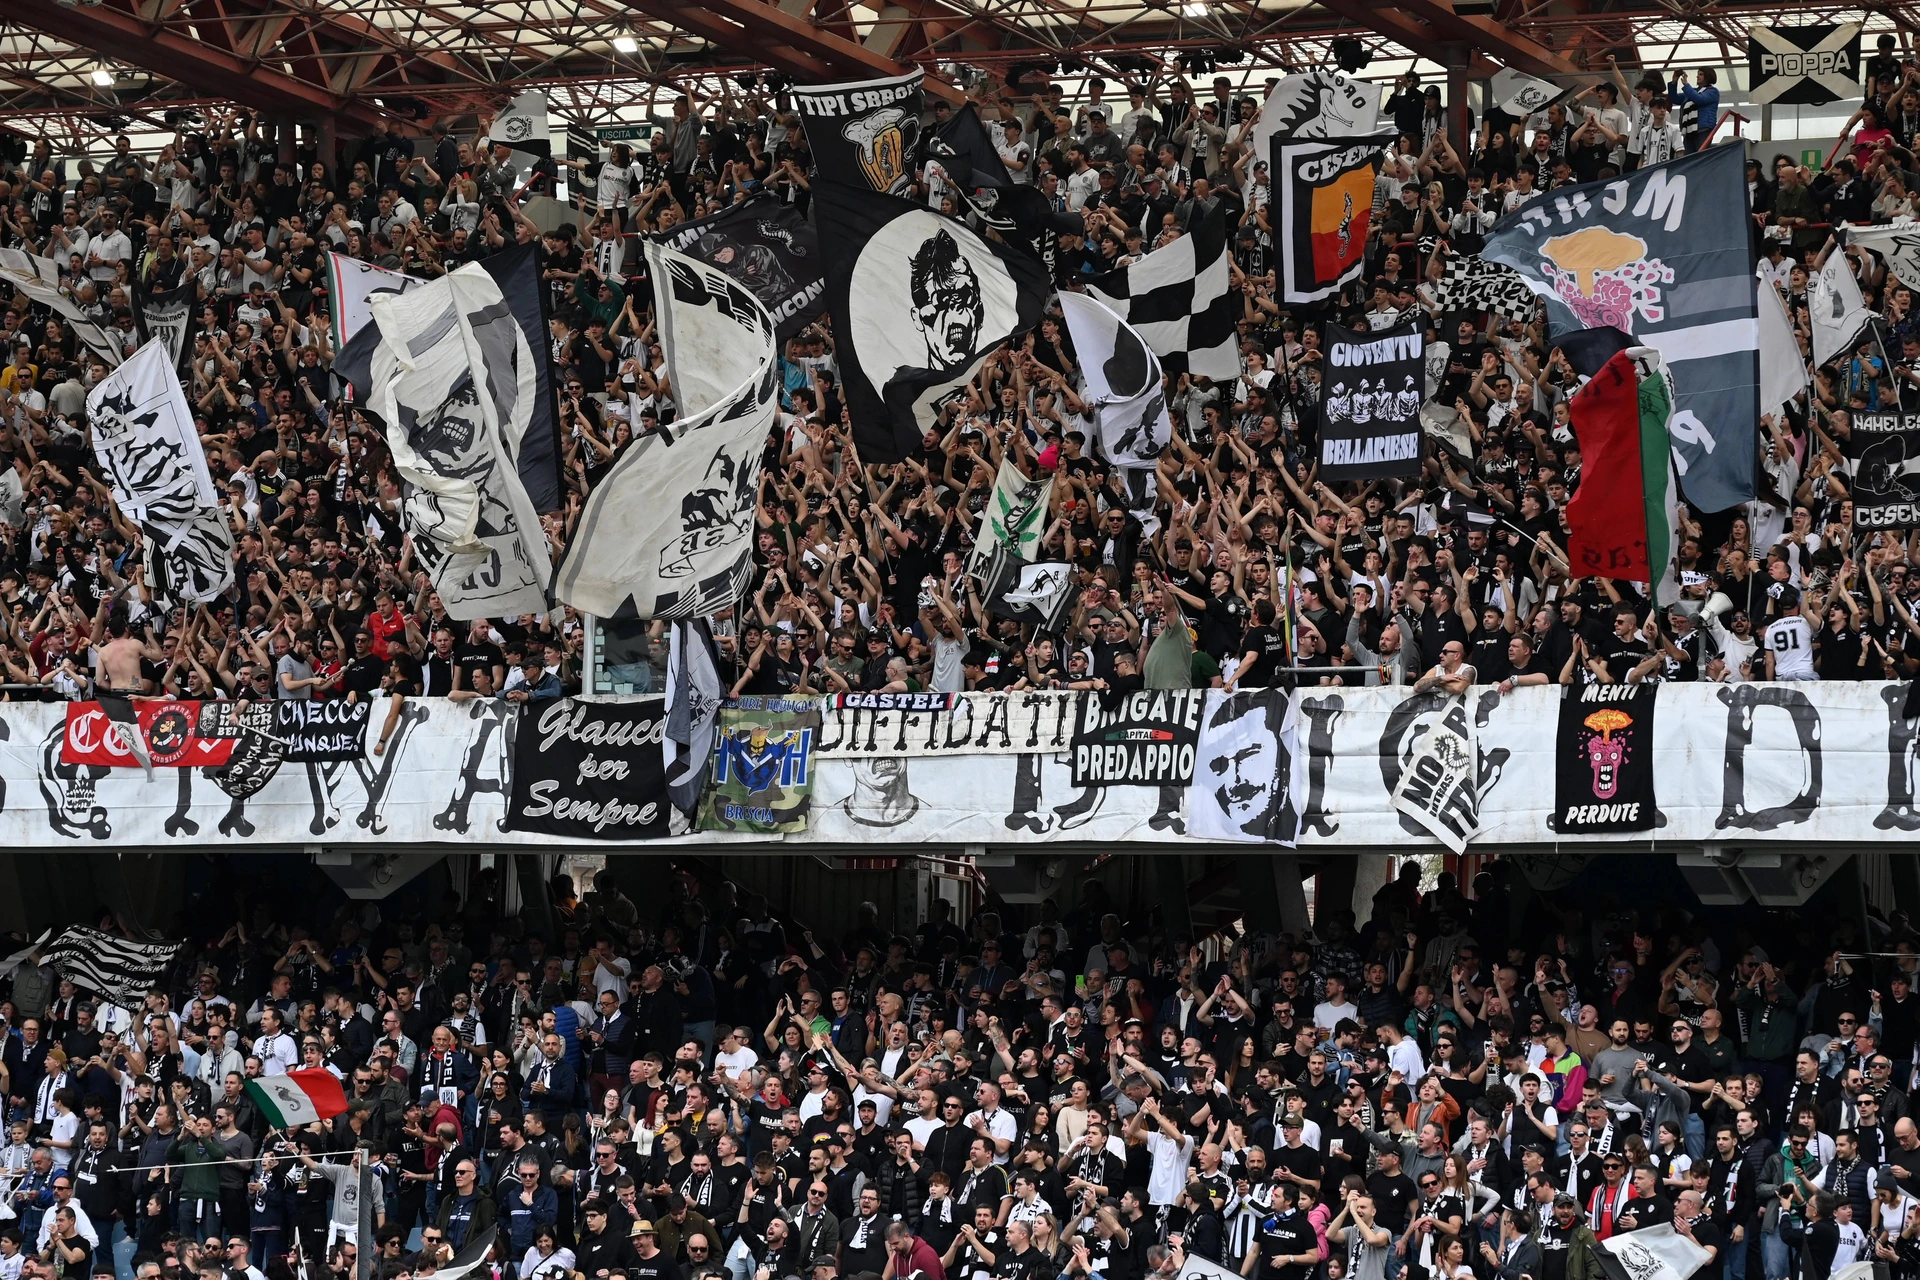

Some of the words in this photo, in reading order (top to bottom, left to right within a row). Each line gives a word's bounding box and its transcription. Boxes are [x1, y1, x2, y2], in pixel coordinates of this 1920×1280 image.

[1761, 50, 1851, 76] PIOPPA
[798, 95, 850, 117] TIPI
[602, 130, 631, 139] USCITA
[1322, 432, 1419, 465] BELLARIESE
[1774, 628, 1800, 652] 91
[845, 693, 945, 709] CASTEL
[1580, 684, 1640, 703] MENTI
[279, 699, 369, 729] CHECCO
[537, 698, 665, 752] Glauco
[818, 693, 1070, 752] DIFFIDATI
[1118, 730, 1160, 739] CAPITALE
[576, 753, 630, 785] per
[1076, 743, 1194, 781] PREDAPPIO
[523, 780, 658, 833] Sempre
[725, 804, 774, 823] BRESCIA
[1564, 802, 1641, 825] PERDUTE
[1840, 1238, 1856, 1246] ESENA
